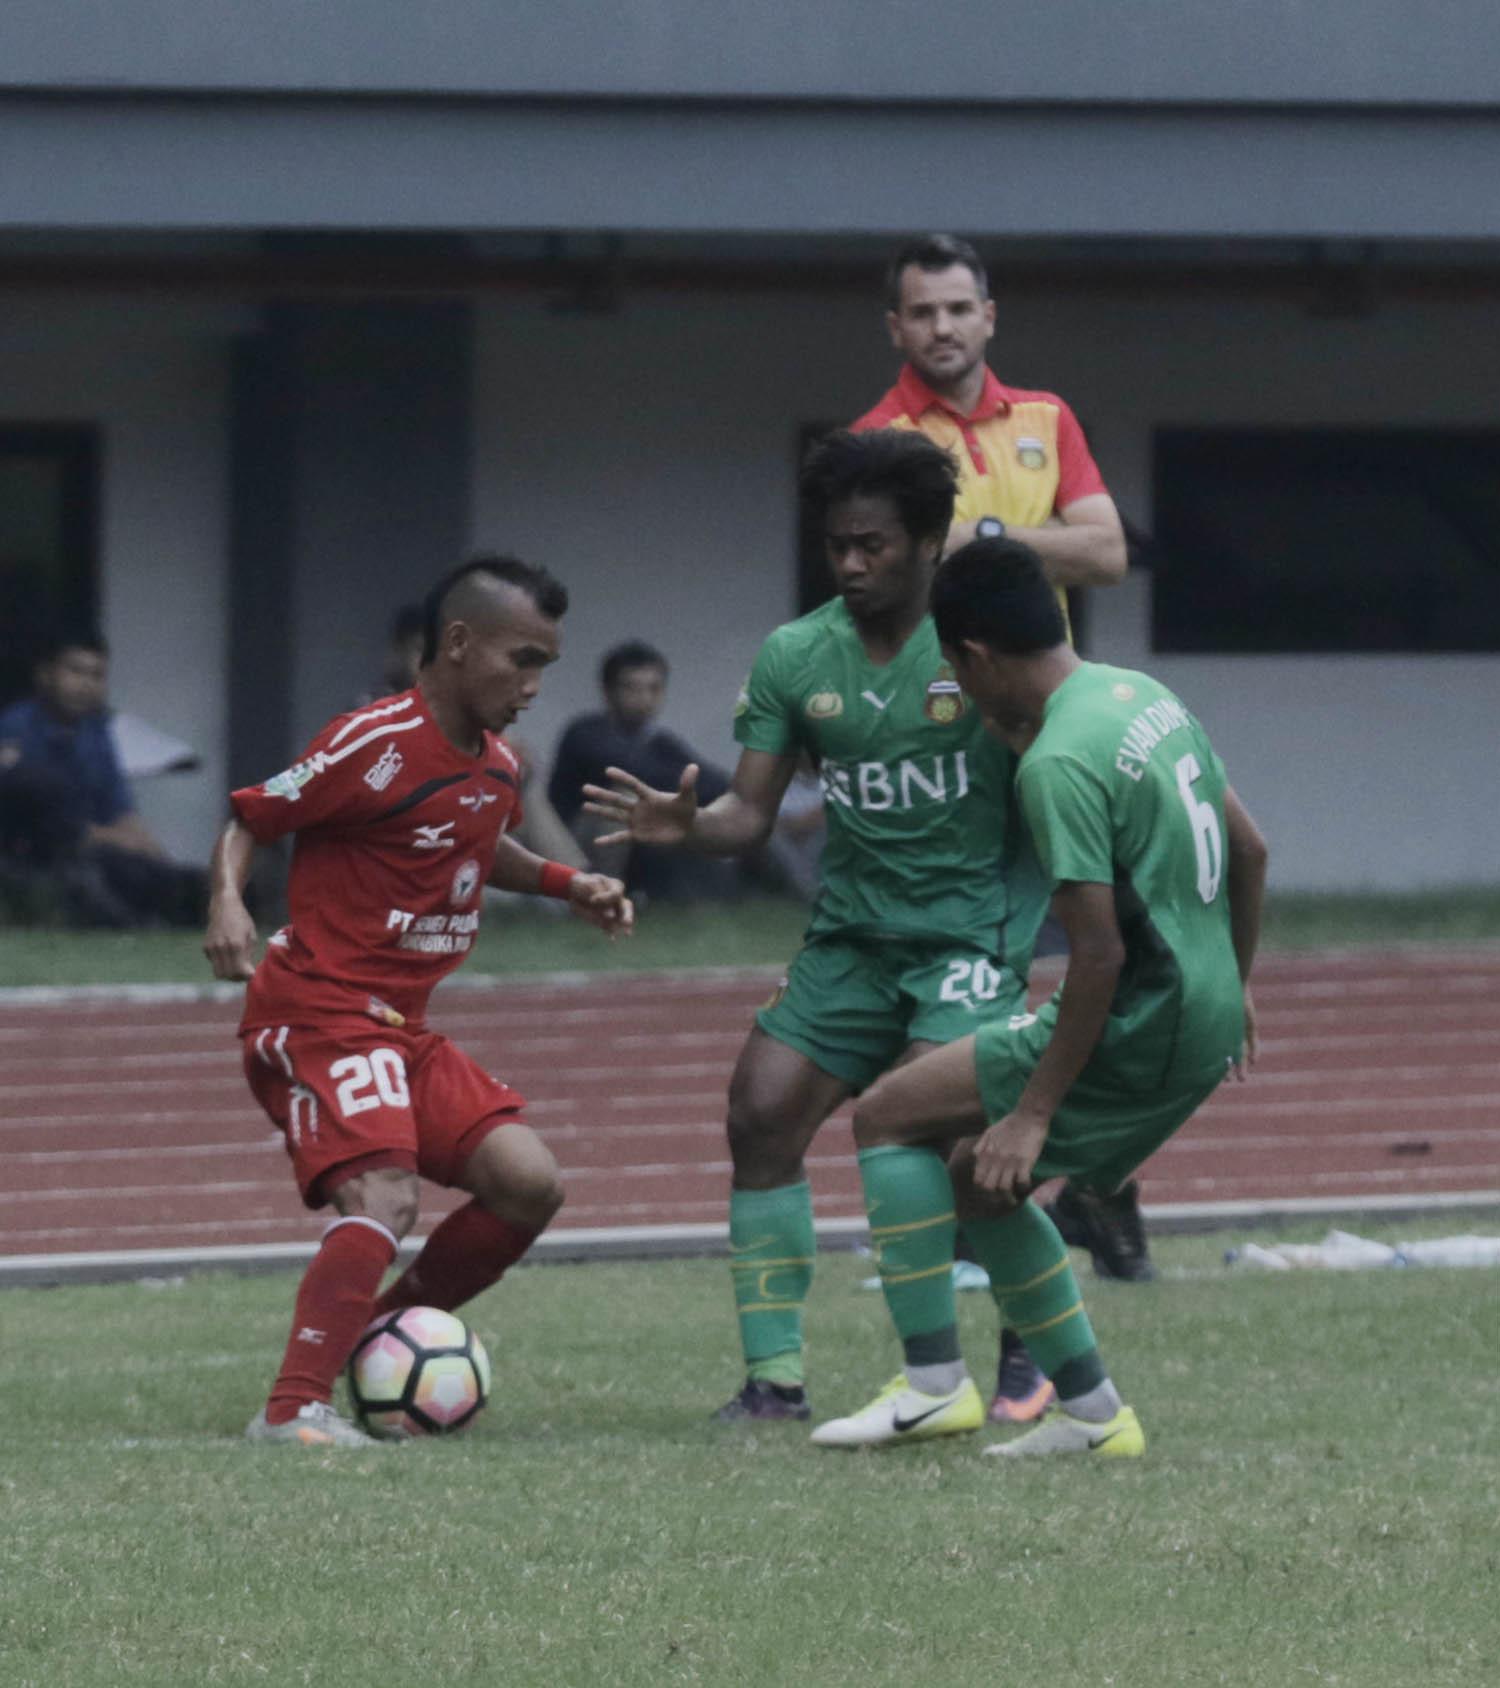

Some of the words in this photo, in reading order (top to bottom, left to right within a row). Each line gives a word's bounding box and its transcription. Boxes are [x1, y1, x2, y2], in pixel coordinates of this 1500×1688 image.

[858, 751, 969, 811] BNI
[1175, 753, 1222, 904] 6
[387, 909, 414, 932] PT
[940, 959, 1001, 1001] 20
[329, 1047, 411, 1117] 20
